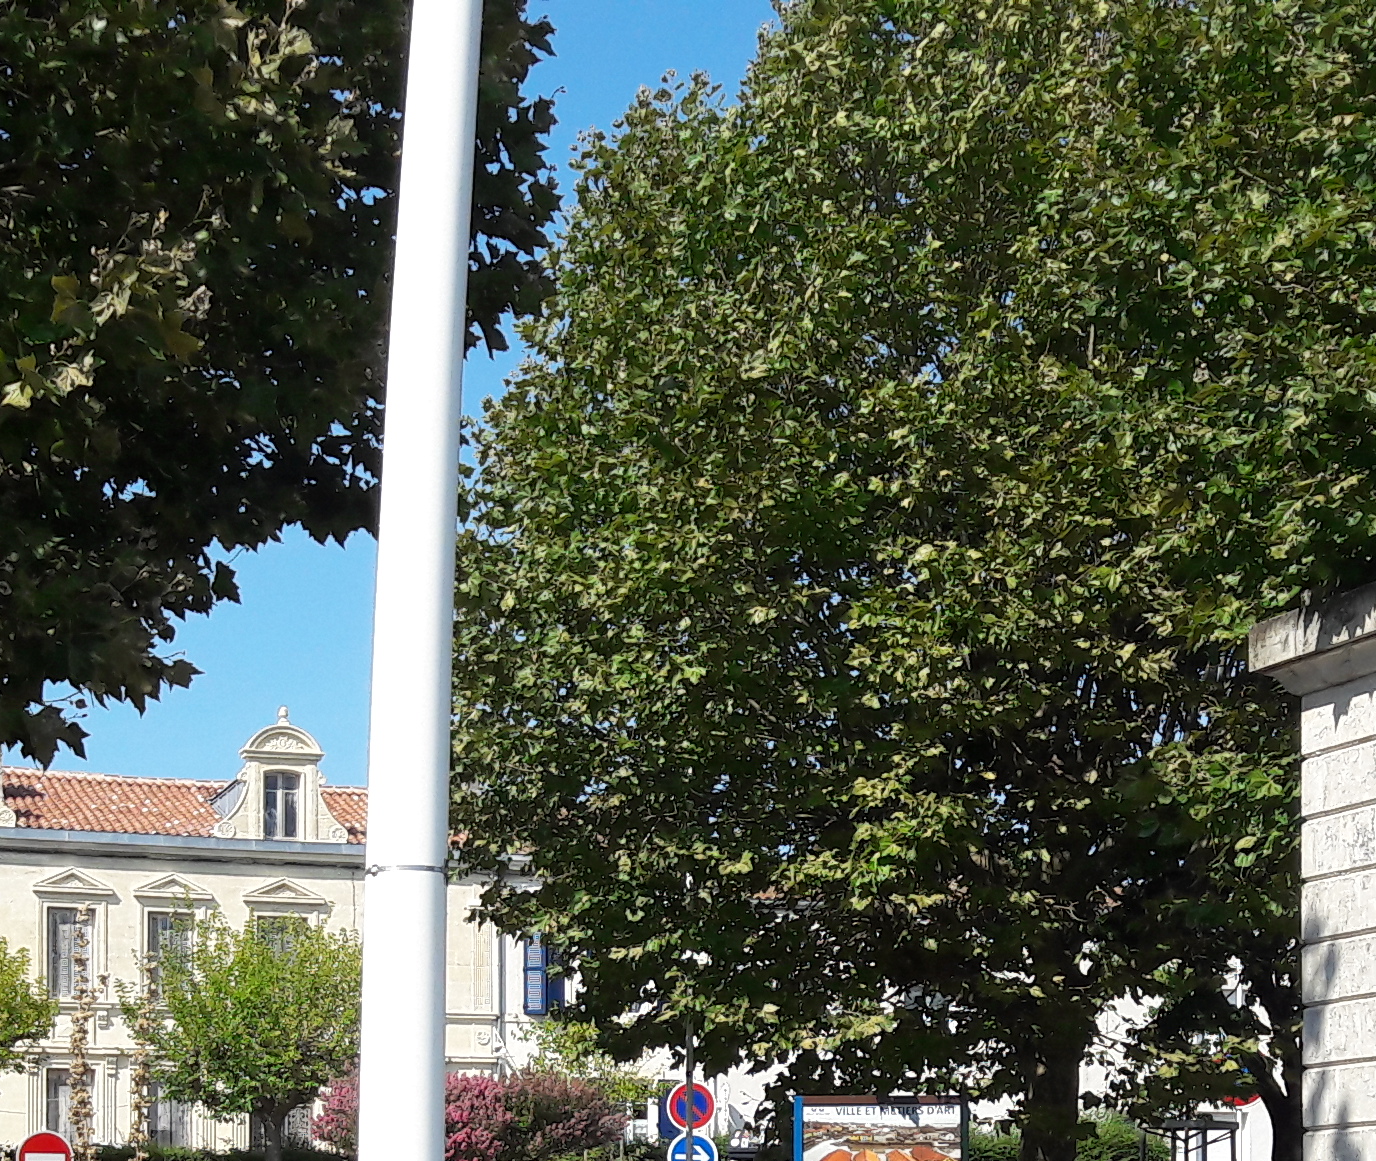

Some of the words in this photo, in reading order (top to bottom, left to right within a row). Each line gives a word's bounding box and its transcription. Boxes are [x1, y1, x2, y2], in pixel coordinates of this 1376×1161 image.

[835, 1106, 862, 1116] VILLE
[865, 1106, 876, 1116] ET
[927, 1105, 956, 1116] D'ART
